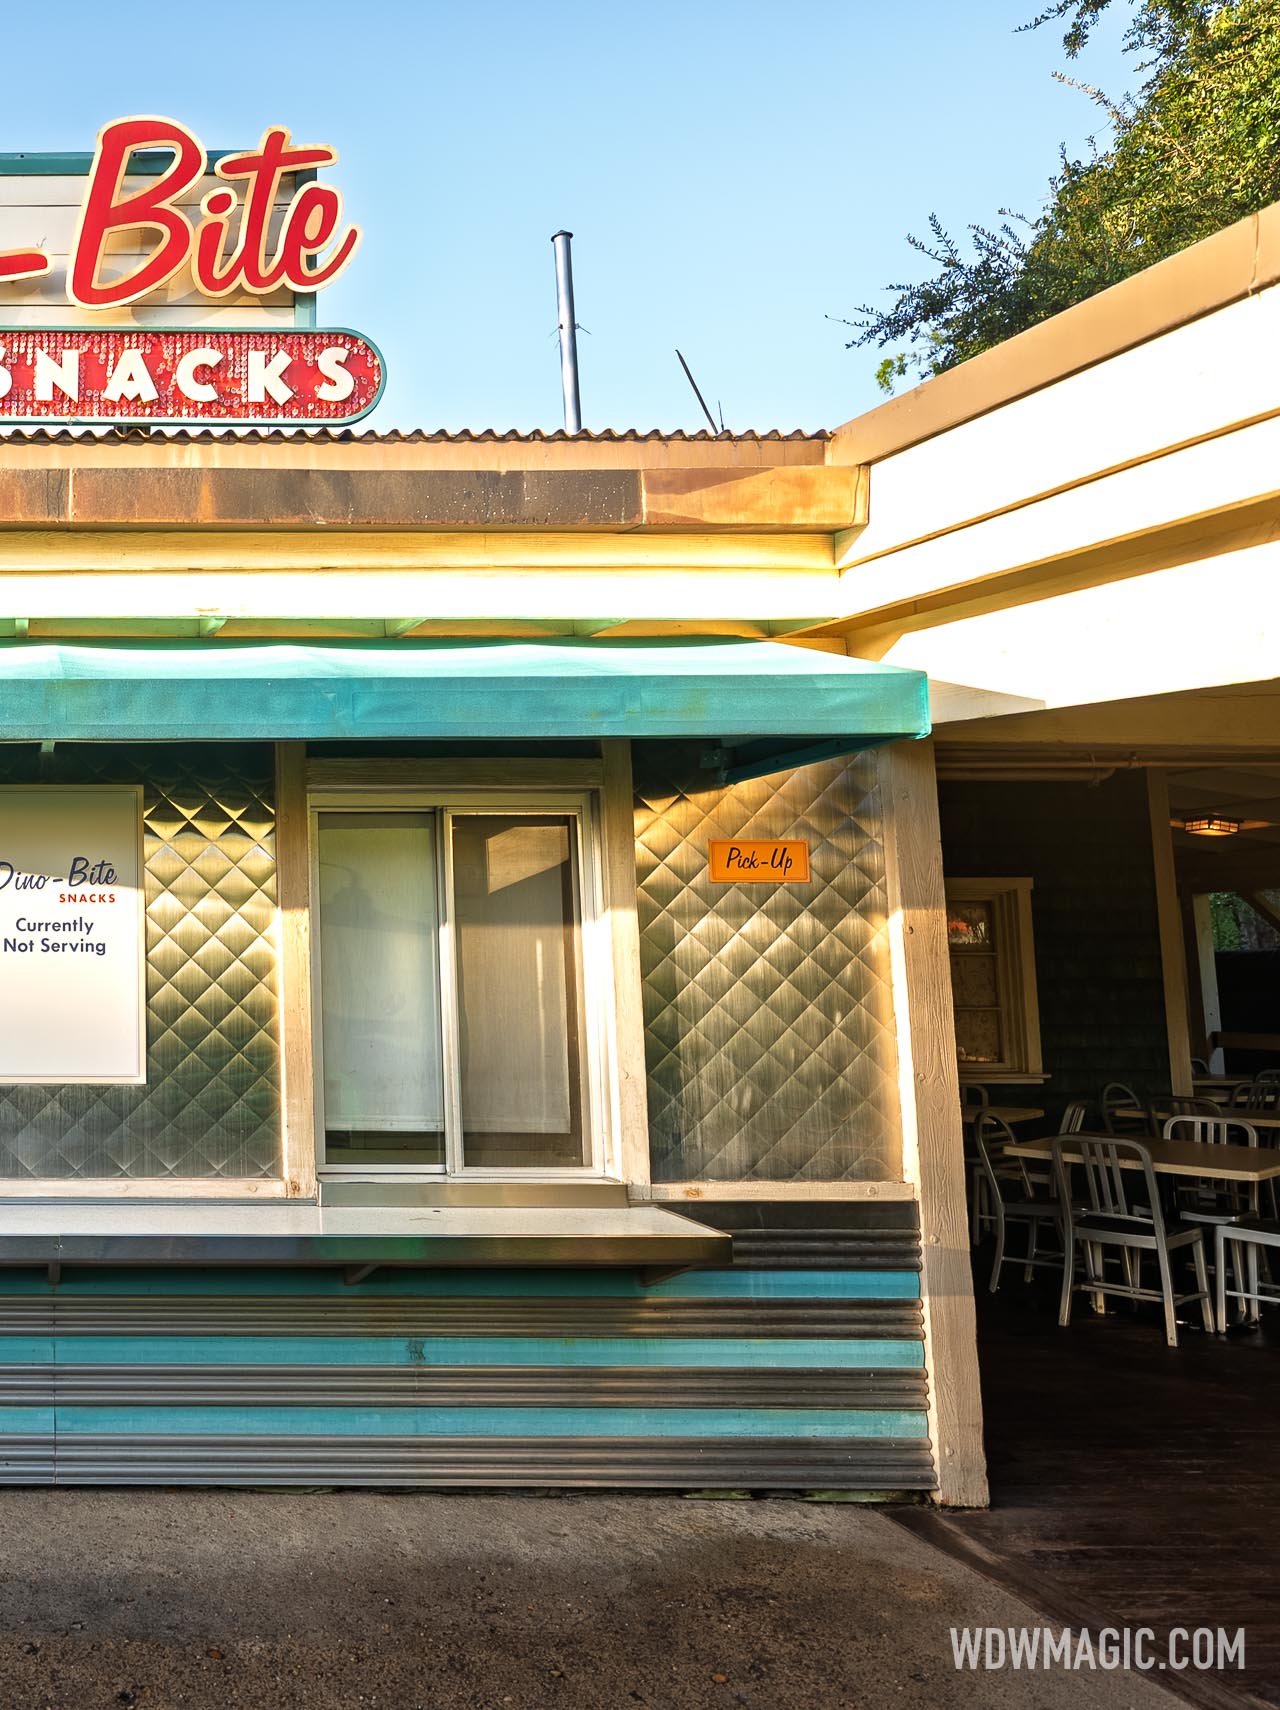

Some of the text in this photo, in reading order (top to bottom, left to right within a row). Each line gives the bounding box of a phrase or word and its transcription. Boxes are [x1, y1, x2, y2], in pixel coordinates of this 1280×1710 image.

[726, 846, 793, 876] Pick-Up
[59, 893, 116, 903] SNACKS
[15, 916, 94, 935] Currently
[3, 938, 106, 956] Not Serving
